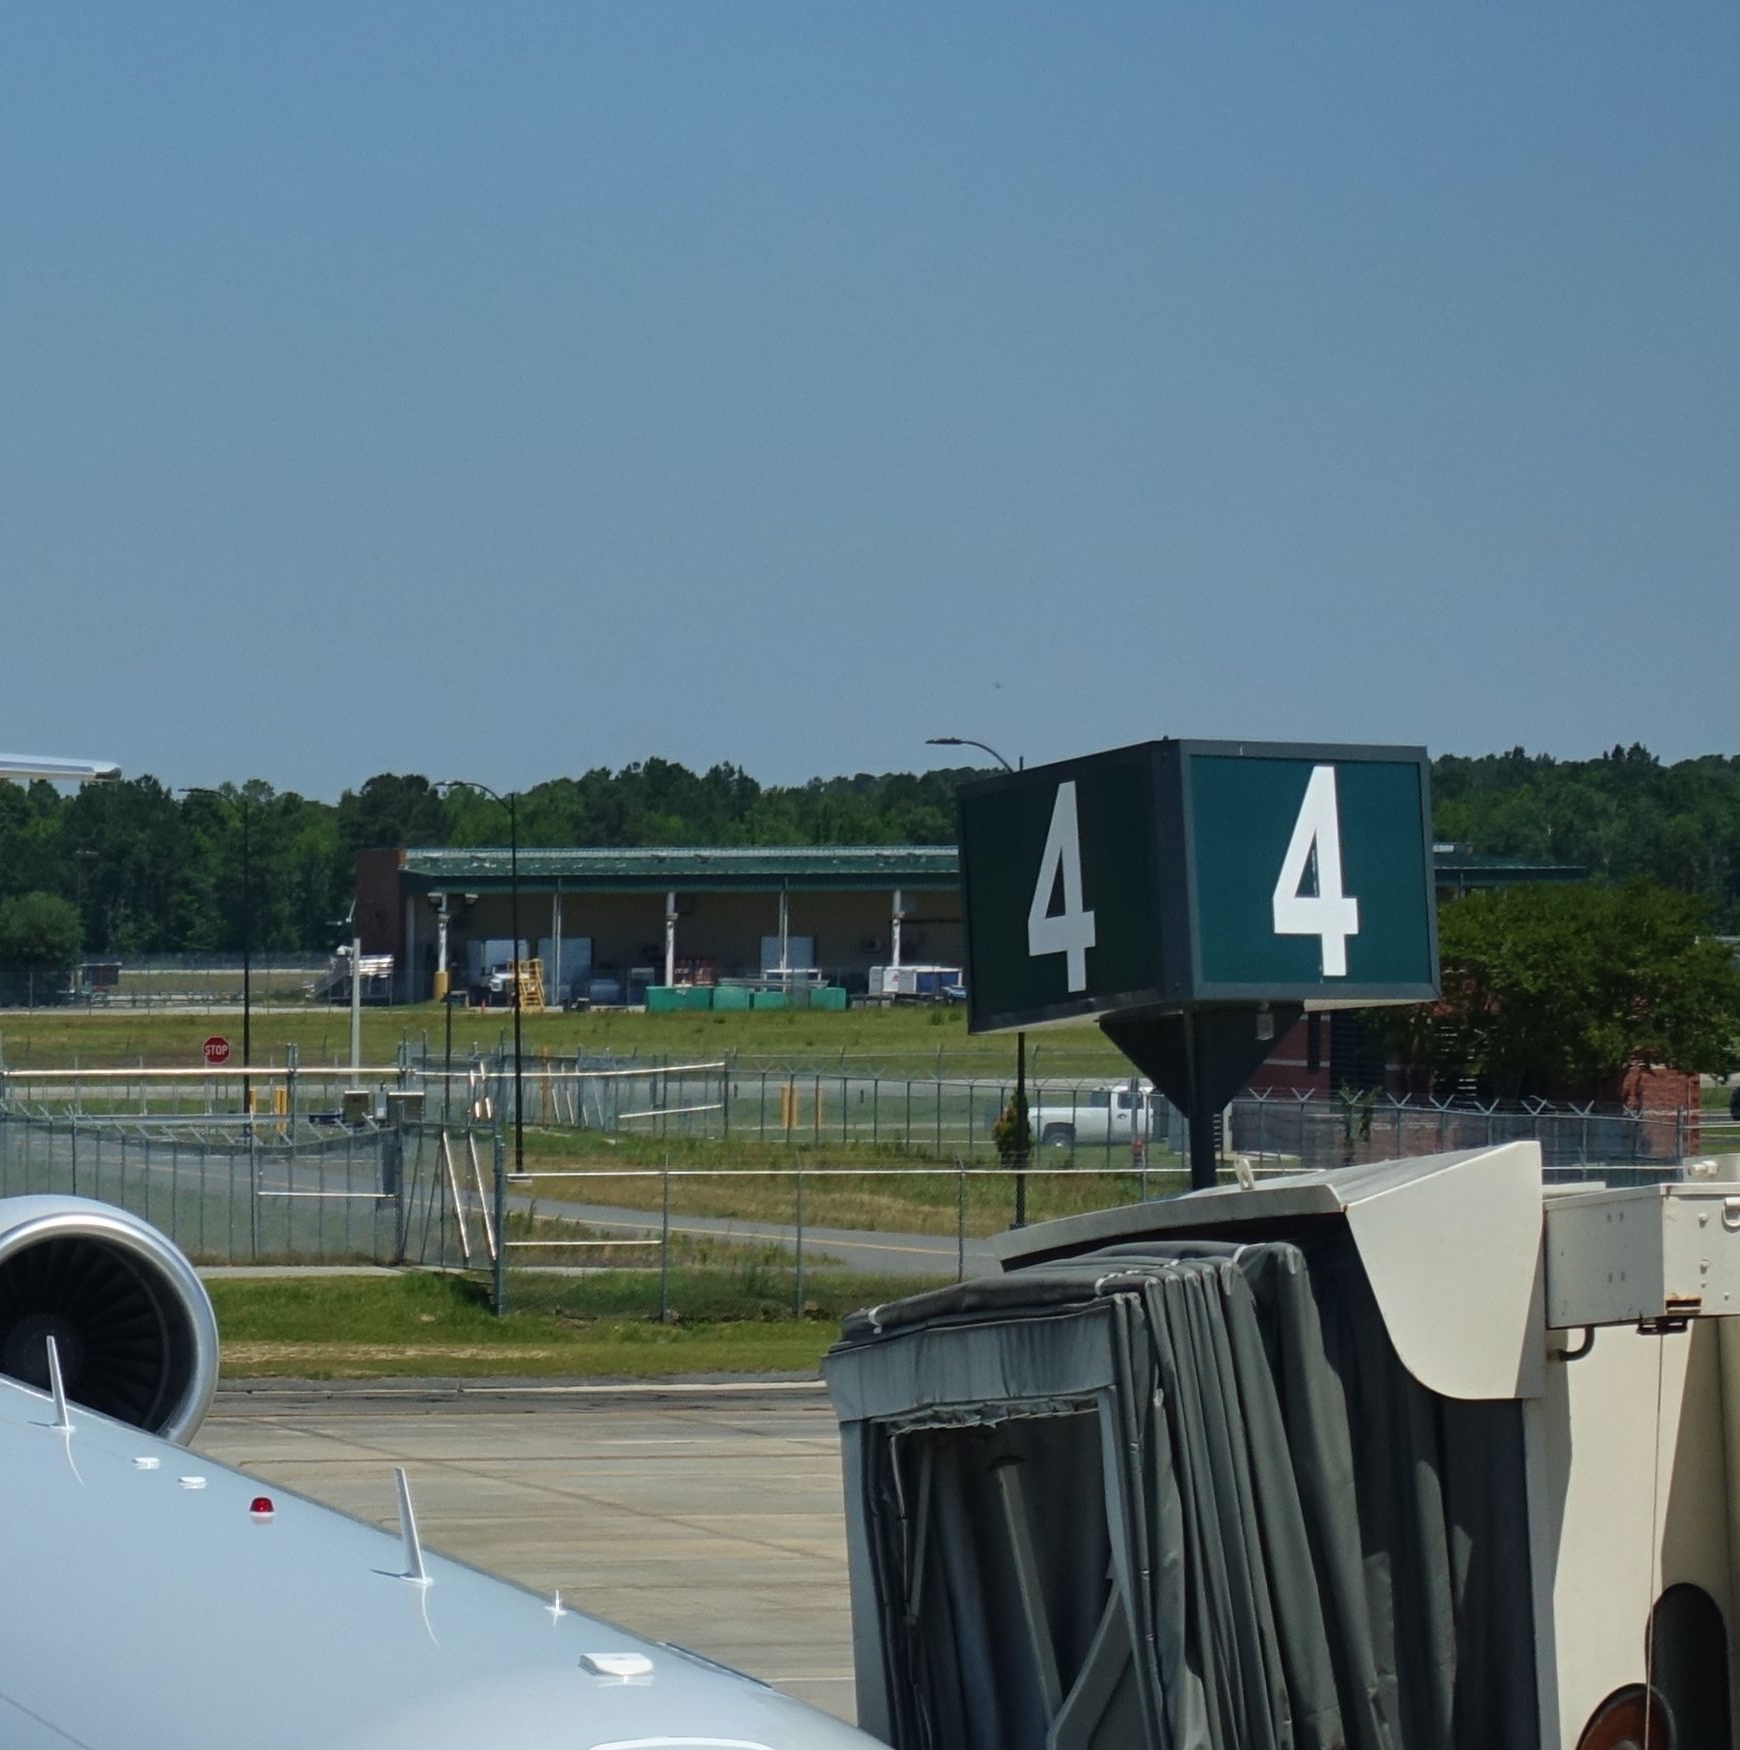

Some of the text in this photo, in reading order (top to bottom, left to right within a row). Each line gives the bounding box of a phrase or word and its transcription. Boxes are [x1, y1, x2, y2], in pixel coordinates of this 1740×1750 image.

[1028, 780, 1096, 992] 4
[1272, 765, 1358, 976] 4
[204, 1045, 228, 1056] STOP
